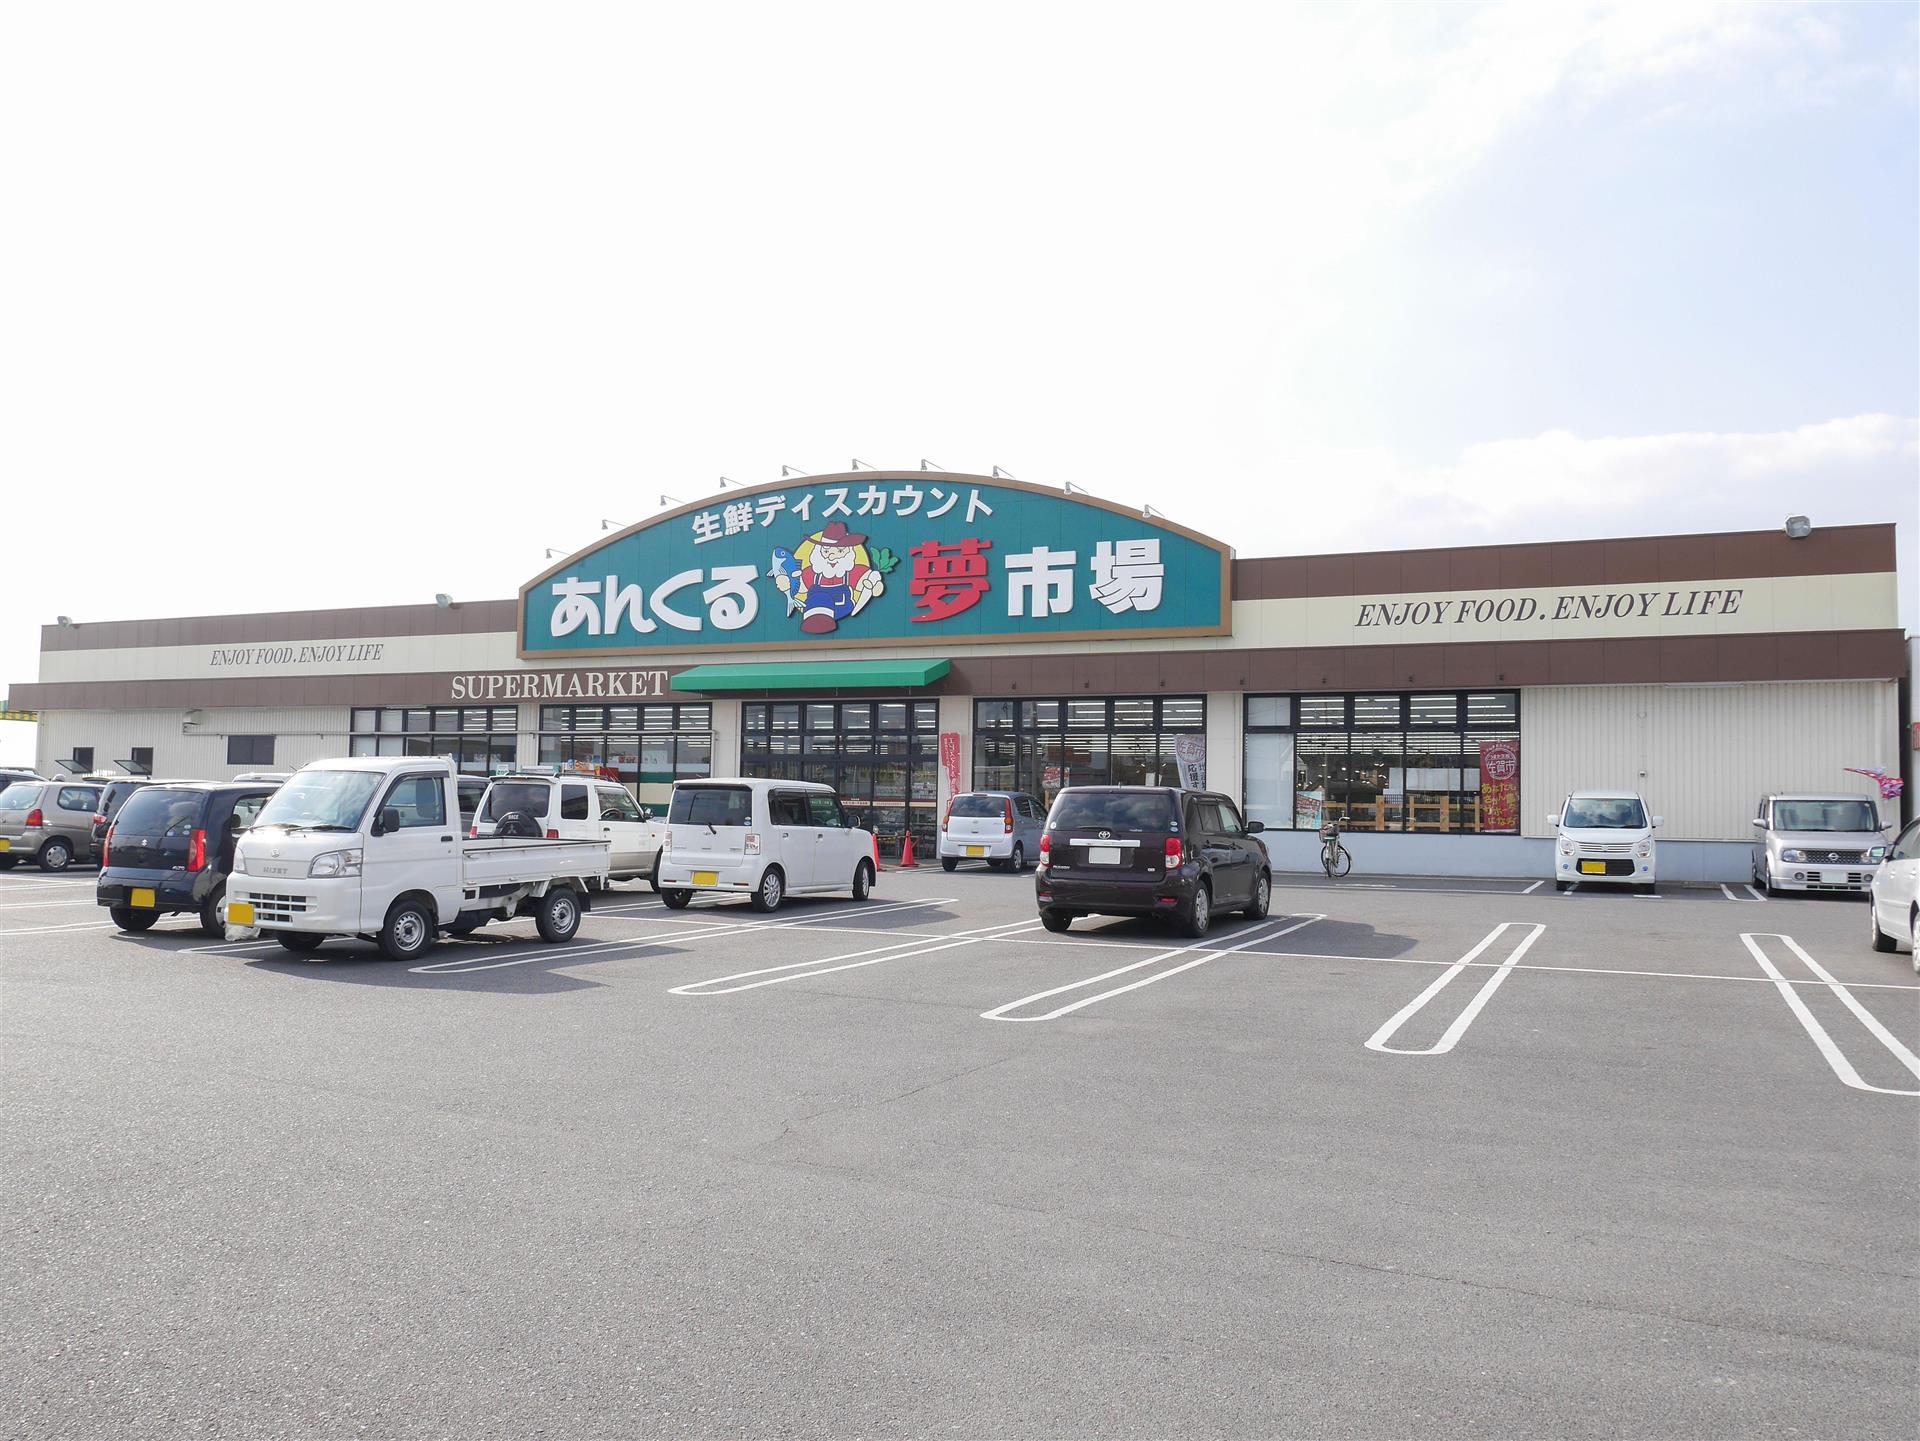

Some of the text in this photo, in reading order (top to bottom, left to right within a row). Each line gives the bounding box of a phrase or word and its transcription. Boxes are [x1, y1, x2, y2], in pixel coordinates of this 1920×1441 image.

[692, 485, 993, 545] 生鮮ディスカウント
[550, 565, 760, 638] あんくる
[1354, 600, 1453, 627] ENJOY
[1551, 592, 1660, 620] ENJOY
[1661, 589, 1744, 617] LIFE
[209, 648, 257, 666] ENJOY
[298, 644, 347, 664] ENJOY
[347, 643, 384, 662] LIFE
[451, 670, 668, 700] SUPERMARKET
[1487, 760, 1516, 775] 佐賀市
